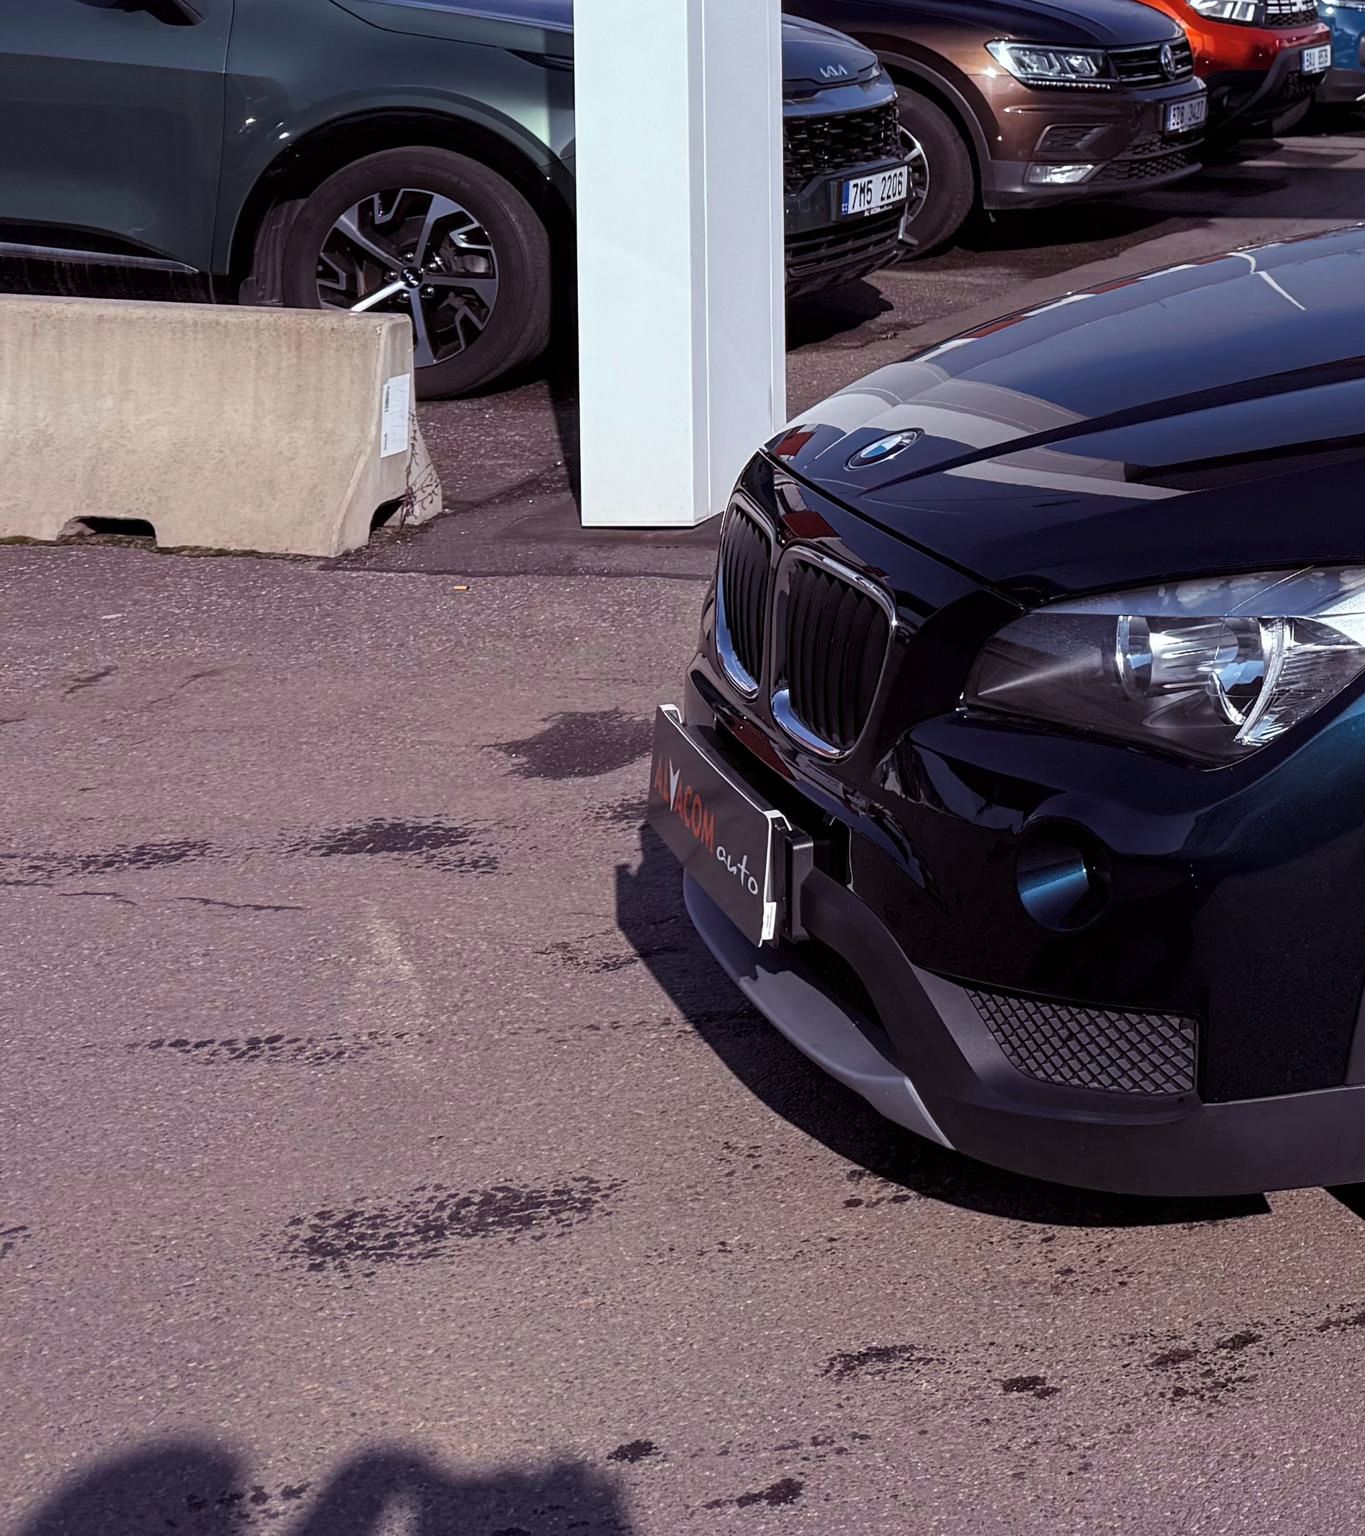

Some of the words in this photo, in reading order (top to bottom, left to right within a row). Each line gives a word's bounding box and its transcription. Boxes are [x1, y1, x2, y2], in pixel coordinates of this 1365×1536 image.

[851, 179, 874, 211] 7M5
[880, 171, 904, 202] 2206
[653, 758, 716, 853] ALVACOM
[715, 845, 759, 895] auto
